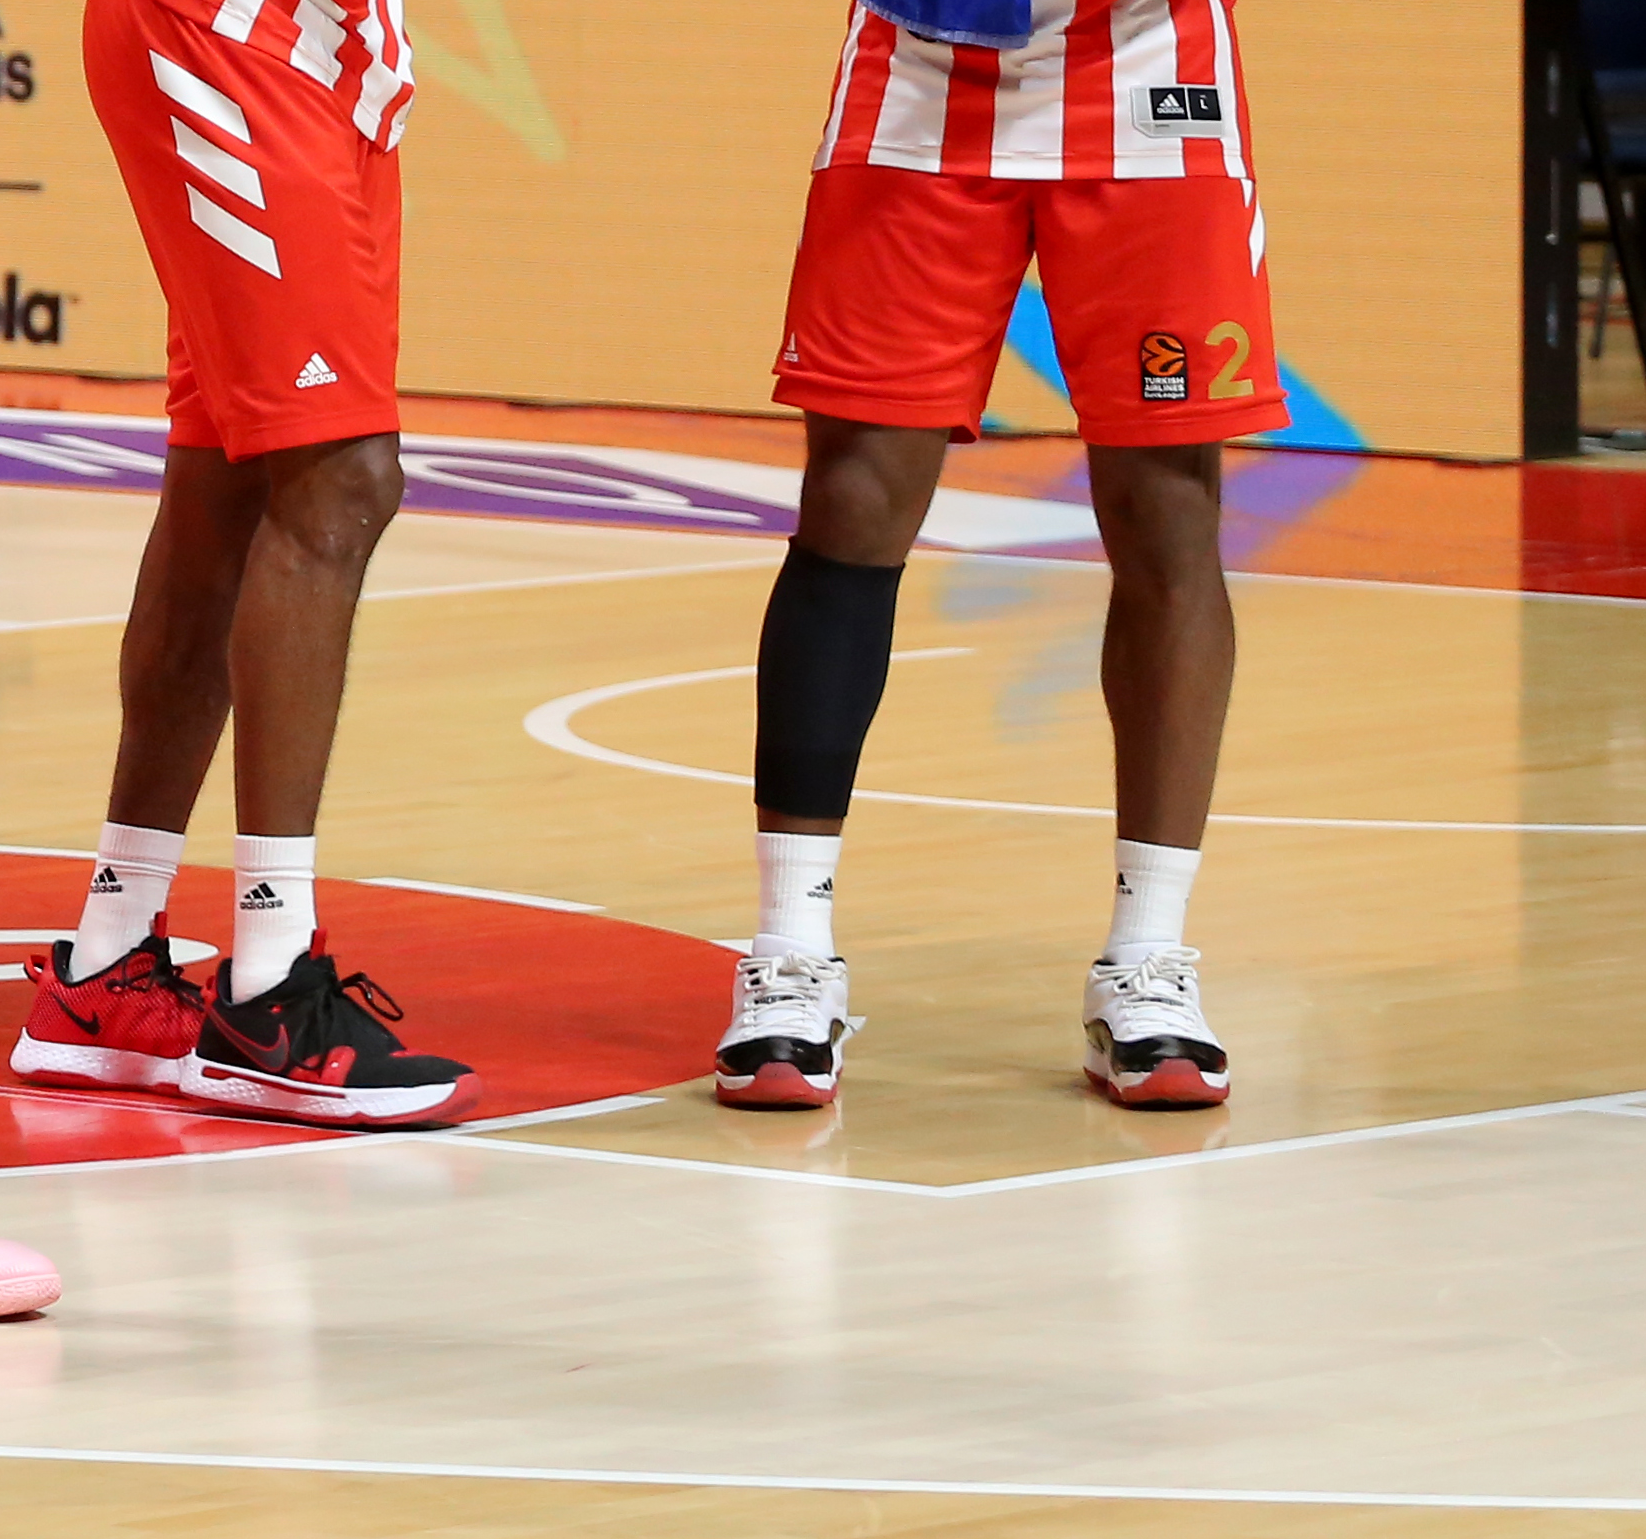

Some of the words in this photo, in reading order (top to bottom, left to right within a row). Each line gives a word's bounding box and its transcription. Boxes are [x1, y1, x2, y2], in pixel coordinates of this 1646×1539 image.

[1205, 321, 1255, 400] 2
[295, 371, 338, 389] adidas
[1144, 376, 1185, 385] TURKISH
[1144, 384, 1185, 392] AIRLINES
[240, 899, 283, 910] adidas
